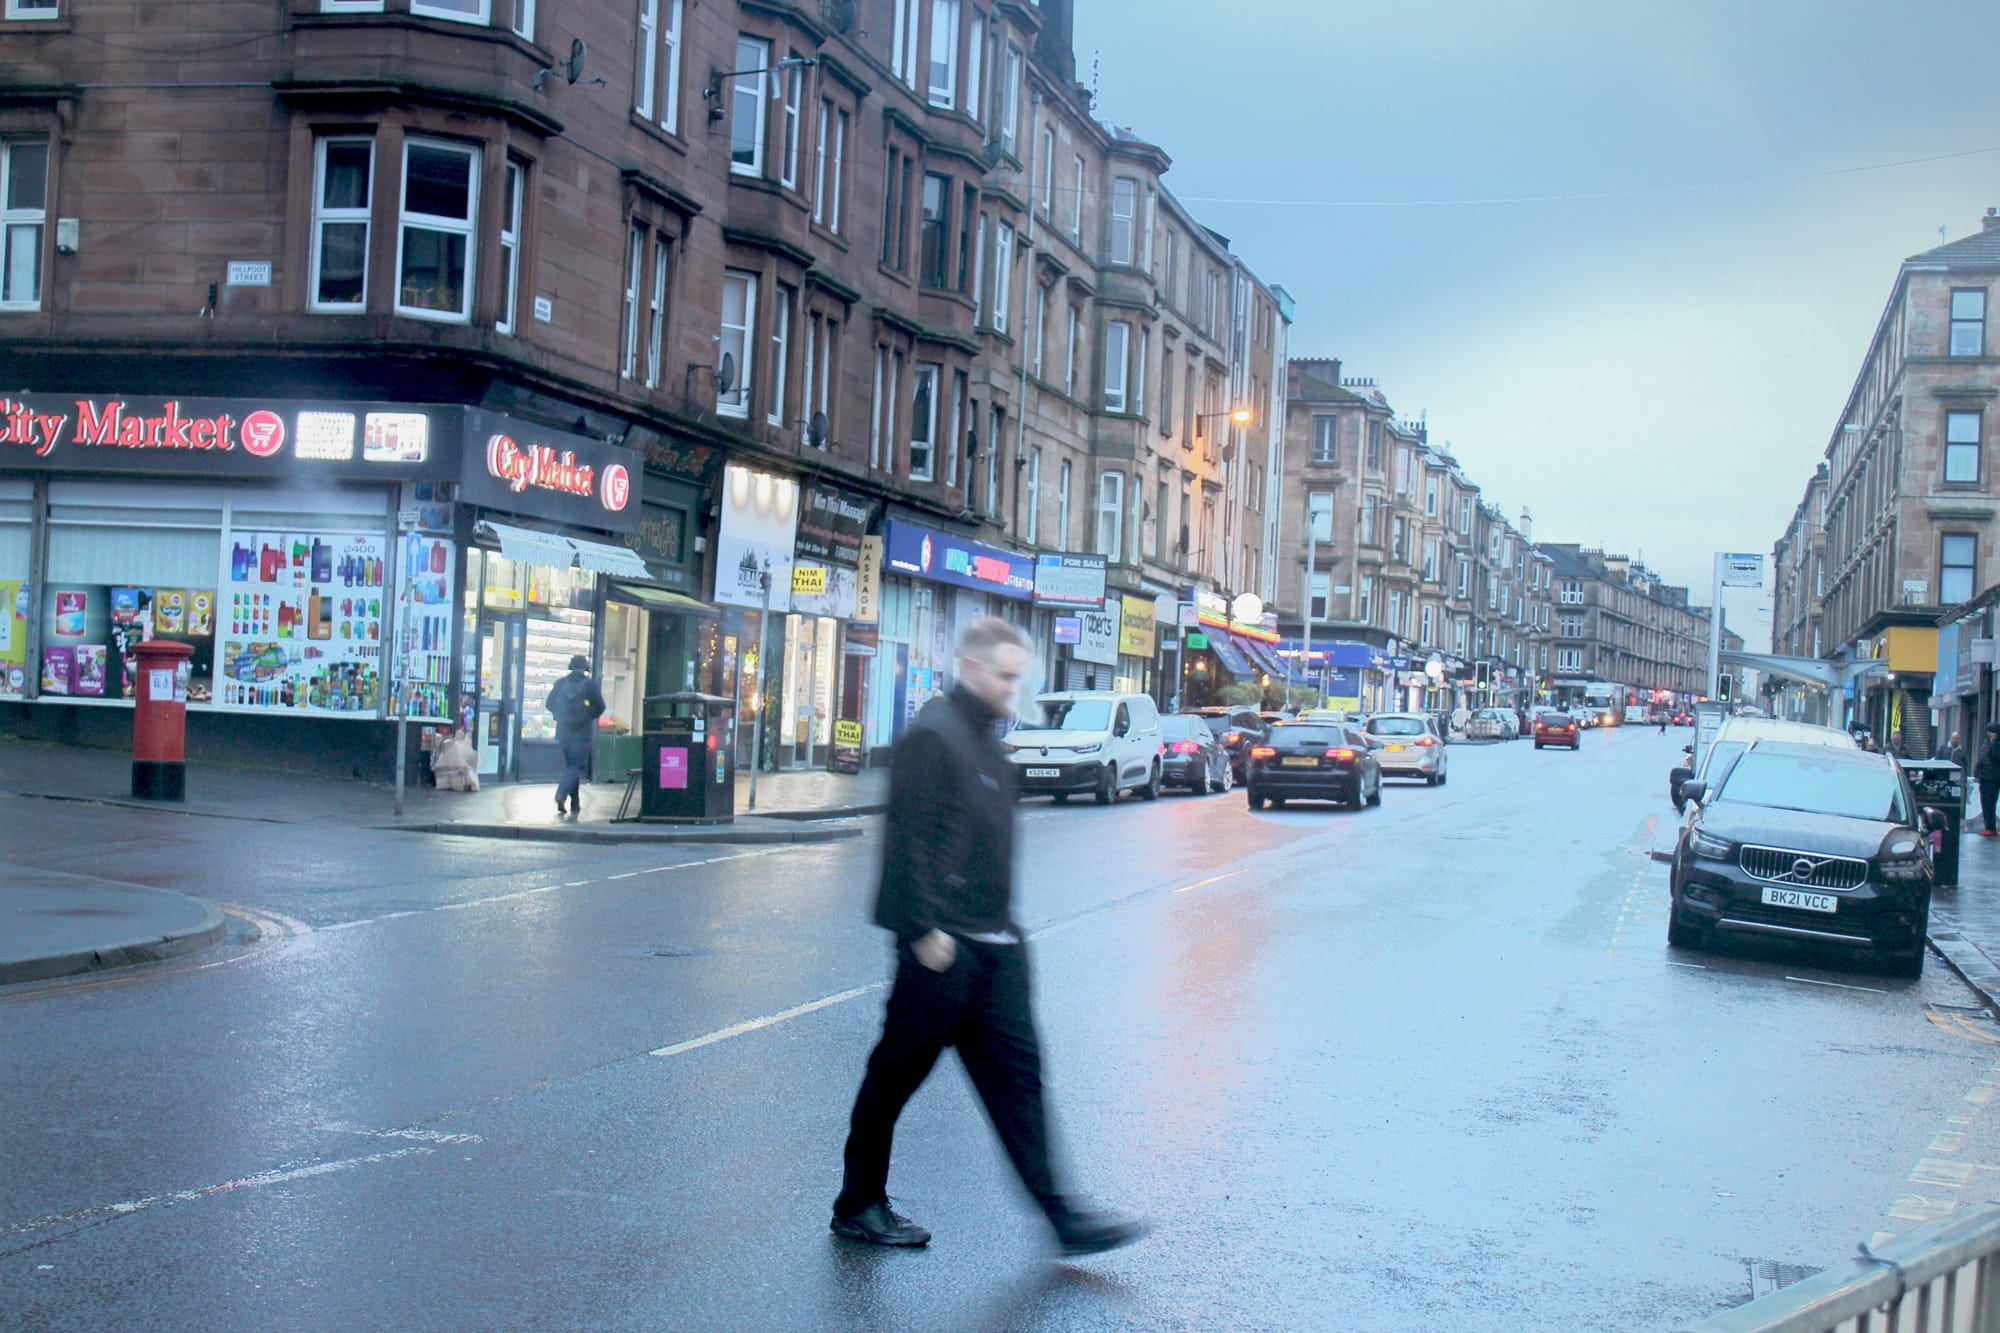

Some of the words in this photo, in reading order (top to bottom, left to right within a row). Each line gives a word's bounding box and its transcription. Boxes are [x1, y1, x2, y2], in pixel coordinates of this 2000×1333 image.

[0, 399, 67, 456] ity
[72, 400, 236, 450] Market
[488, 435, 531, 492] City
[529, 444, 596, 496] Market
[343, 545, 376, 553] 2400
[1063, 558, 1081, 567] FOR
[1082, 559, 1105, 569] SALE
[799, 568, 818, 577] NIM
[793, 577, 822, 587] THAI
[861, 543, 873, 615] MASSAGE
[838, 730, 859, 739] THAI
[1771, 890, 1800, 905] BK21
[1804, 894, 1829, 909] VCC
